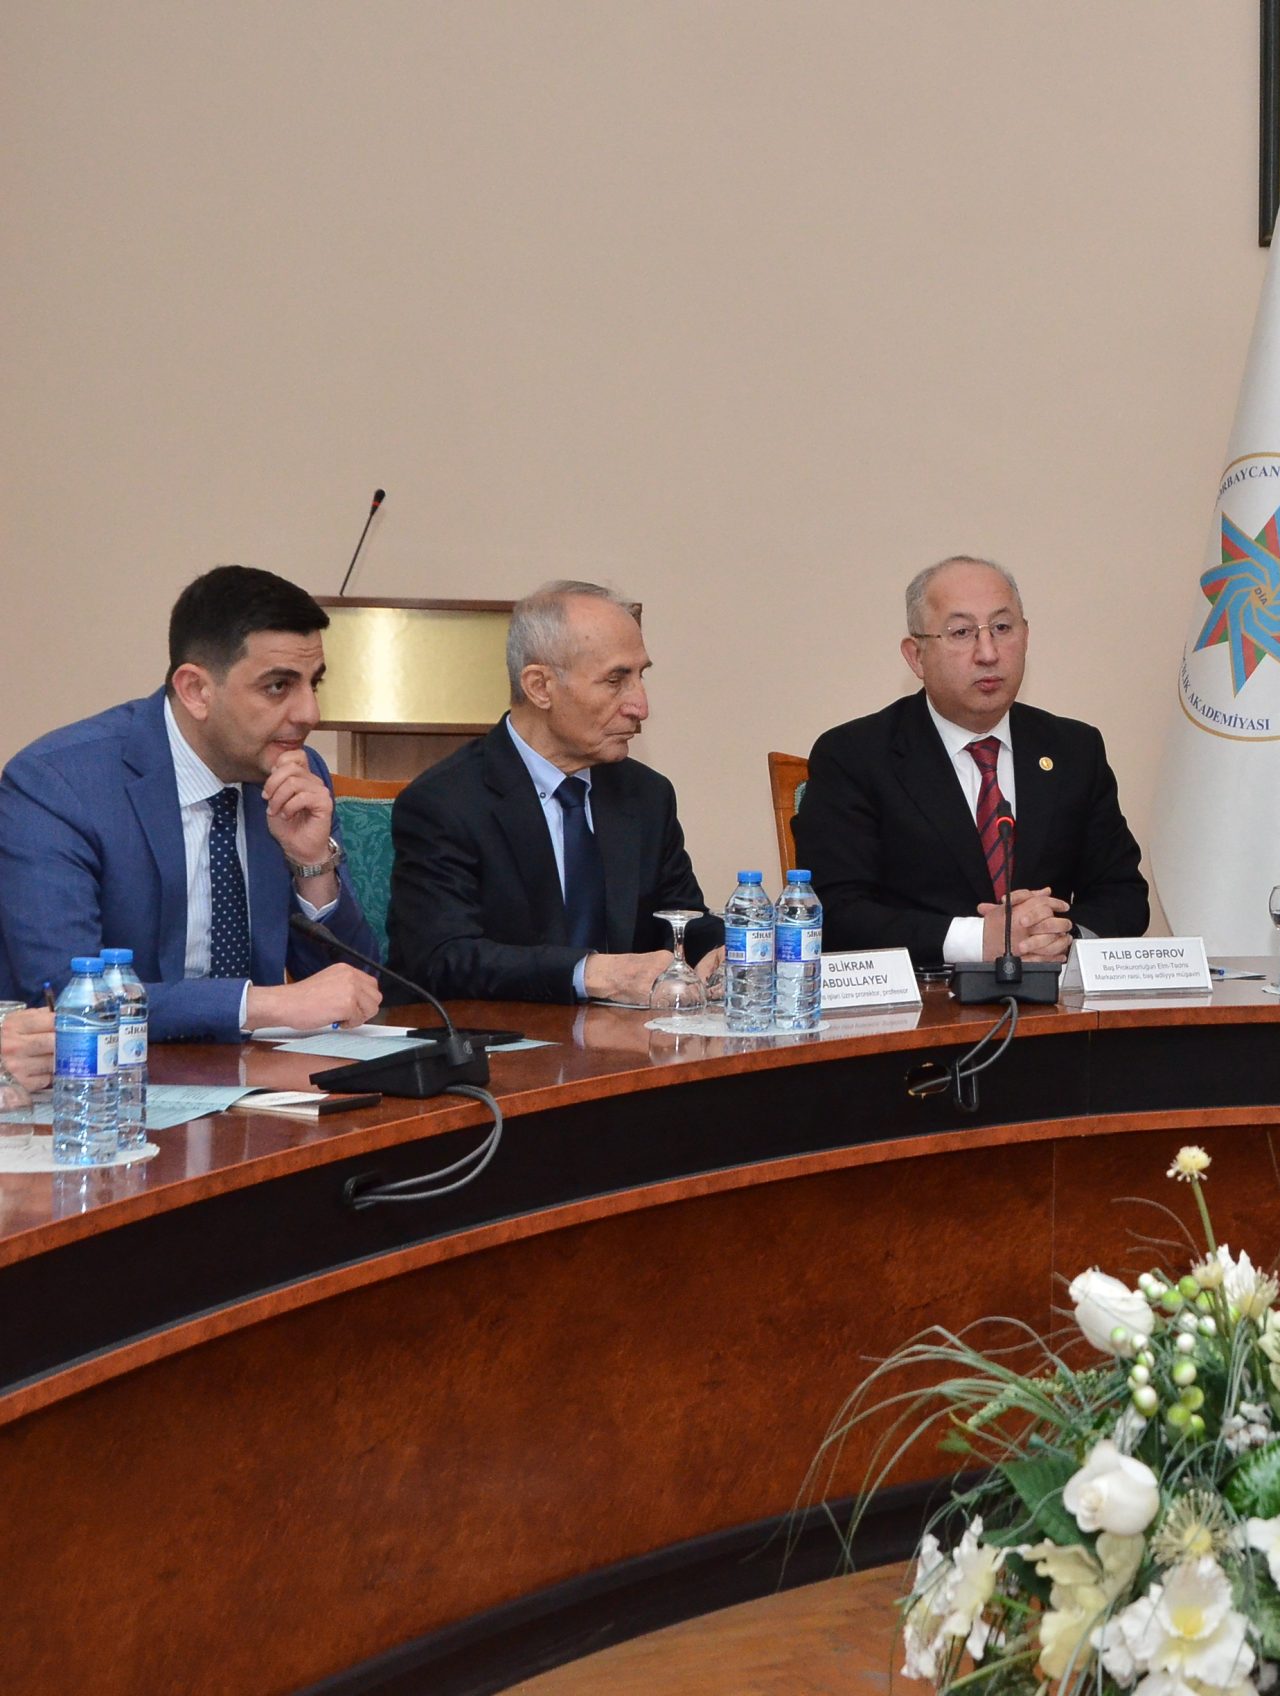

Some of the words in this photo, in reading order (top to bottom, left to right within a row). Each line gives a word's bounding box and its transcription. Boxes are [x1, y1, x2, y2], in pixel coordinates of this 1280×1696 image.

[1188, 692, 1270, 731] AKADEMİYASI
[1101, 949, 1133, 961] TALIB
[1134, 948, 1185, 959] CƏFƏROV
[828, 960, 875, 973] ƏLİKRAM
[822, 974, 888, 989] ABDULLAYEV
